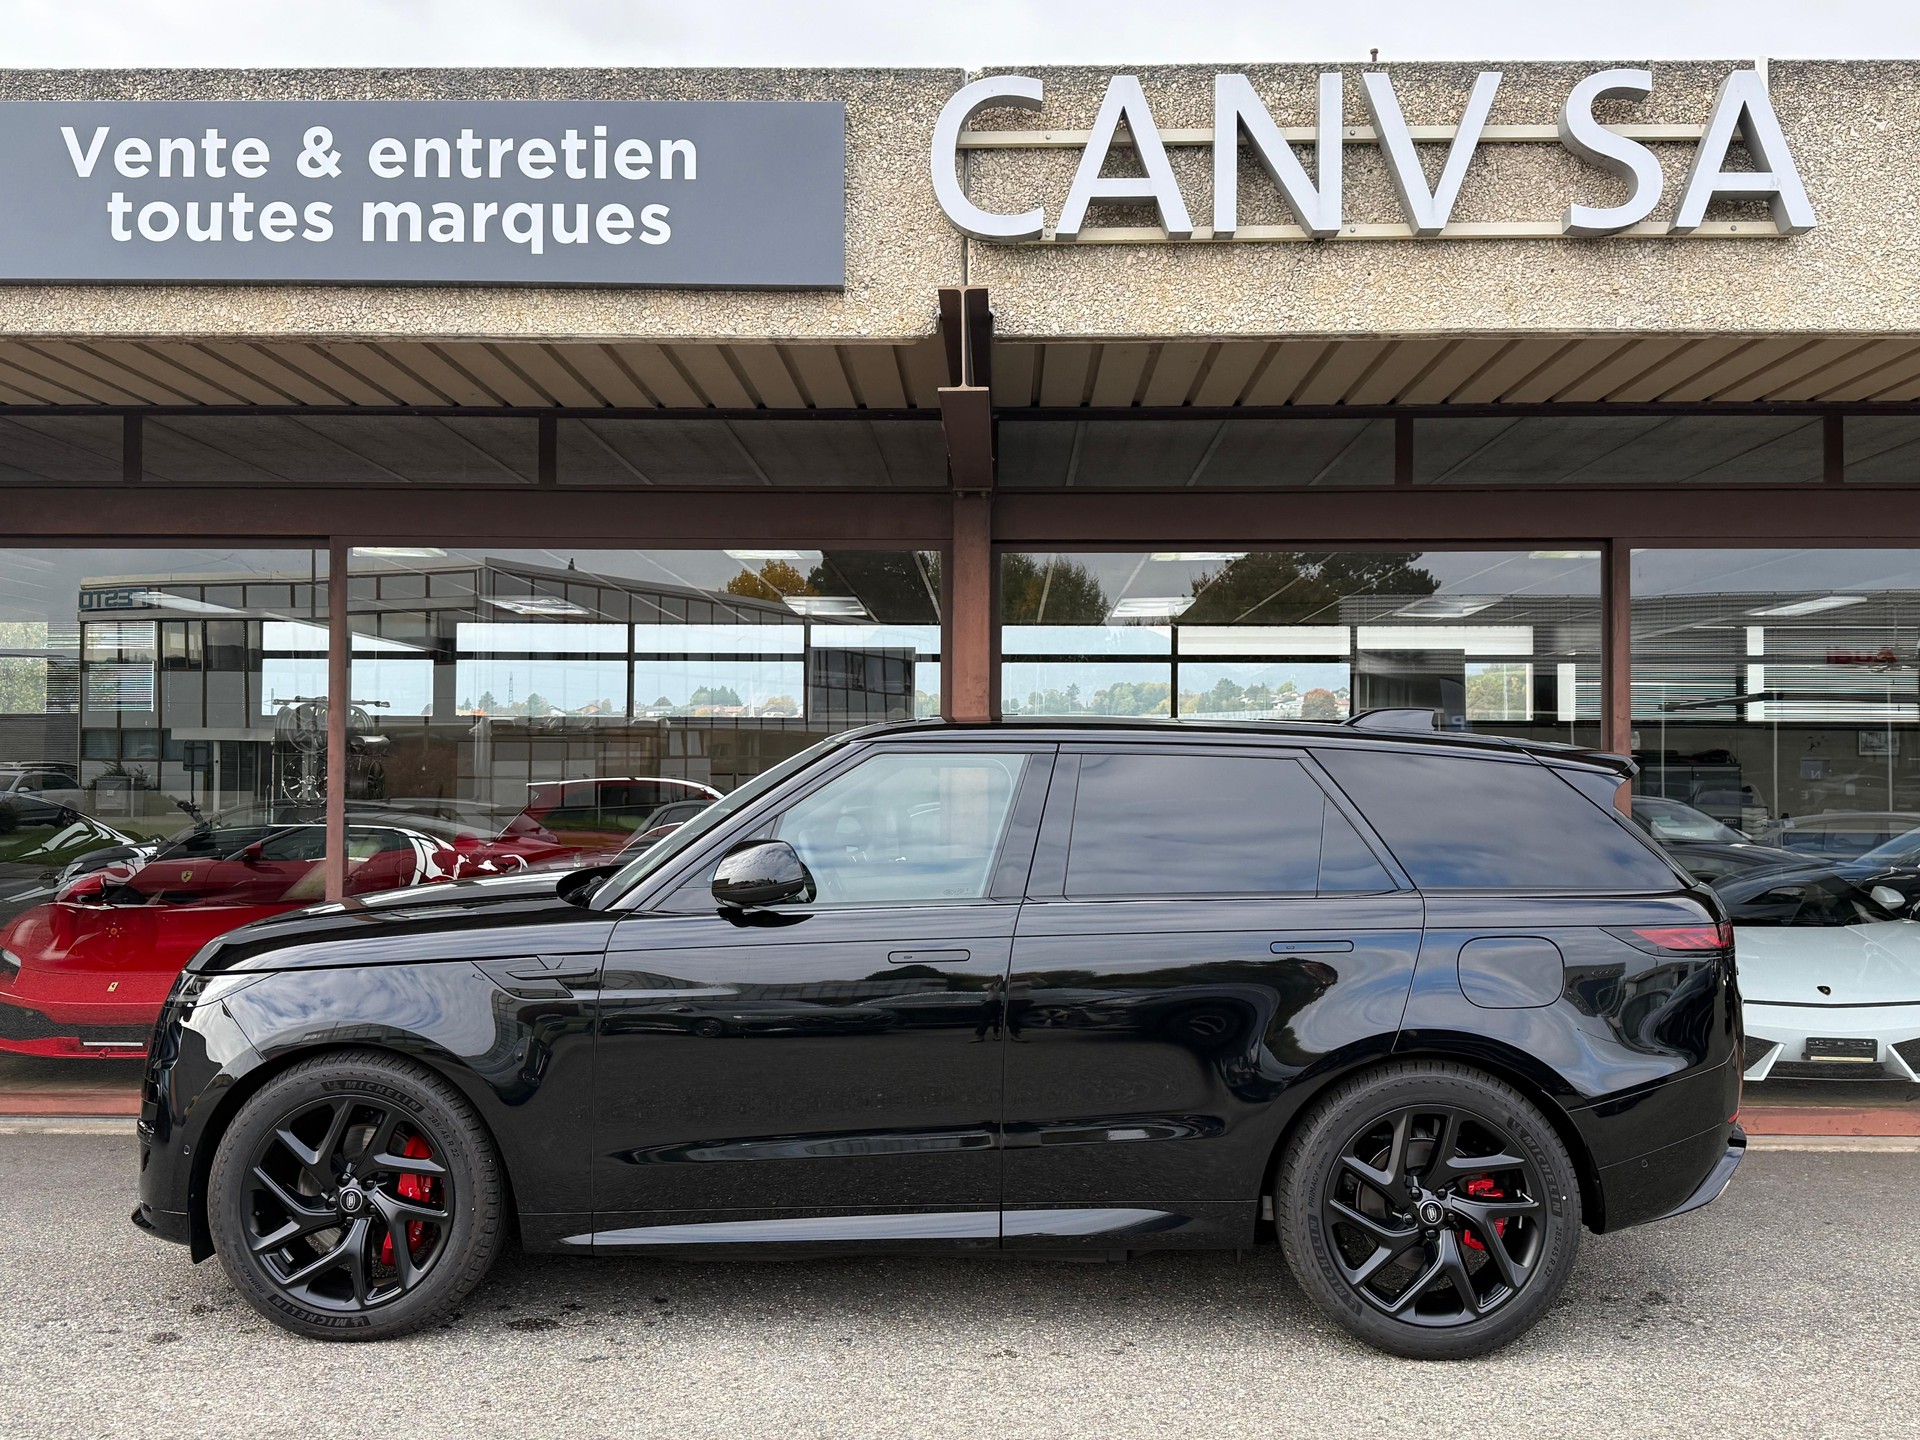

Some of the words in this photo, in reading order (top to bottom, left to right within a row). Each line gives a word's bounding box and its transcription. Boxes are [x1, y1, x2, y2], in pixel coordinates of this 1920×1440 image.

[60, 126, 271, 179] Vente
[296, 125, 342, 179] &
[368, 125, 697, 180] entretien
[930, 71, 1504, 241] CANV
[1559, 68, 1817, 238] SA
[107, 192, 334, 243] toutes
[362, 201, 671, 255] marques
[344, 1080, 421, 1110] MICHELIN
[428, 1114, 450, 1140] 285/45
[450, 1148, 461, 1158] 22
[1308, 1171, 1320, 1208] PRIMACY
[1523, 1134, 1561, 1214] MICHELIN
[1309, 1219, 1347, 1297] MICHELIN
[1551, 1226, 1562, 1259] 285/45
[239, 1263, 265, 1294] PRIMACY
[272, 1295, 348, 1327] MICHELIN
